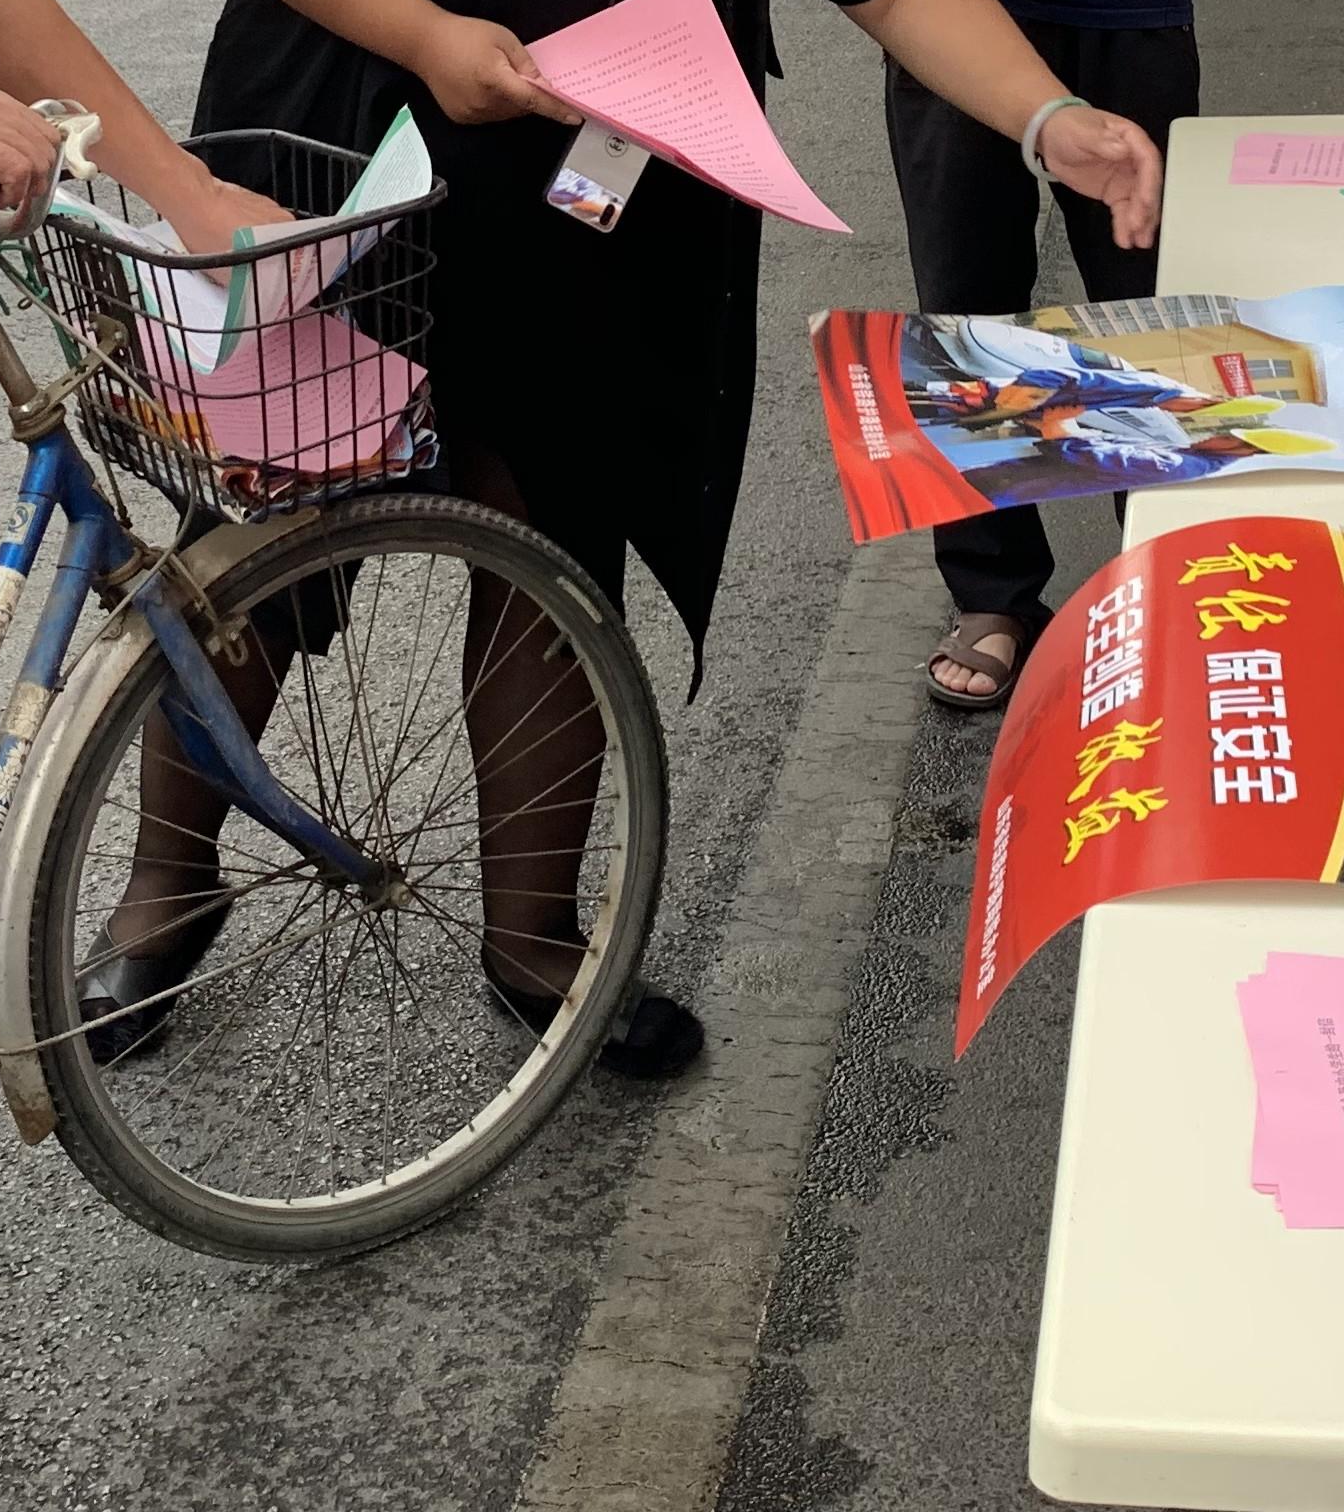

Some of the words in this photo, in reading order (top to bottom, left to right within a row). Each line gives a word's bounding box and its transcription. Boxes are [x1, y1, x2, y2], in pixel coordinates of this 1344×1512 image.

[1077, 576, 1146, 732] 安全创造
[1204, 648, 1299, 807] 保证安全
